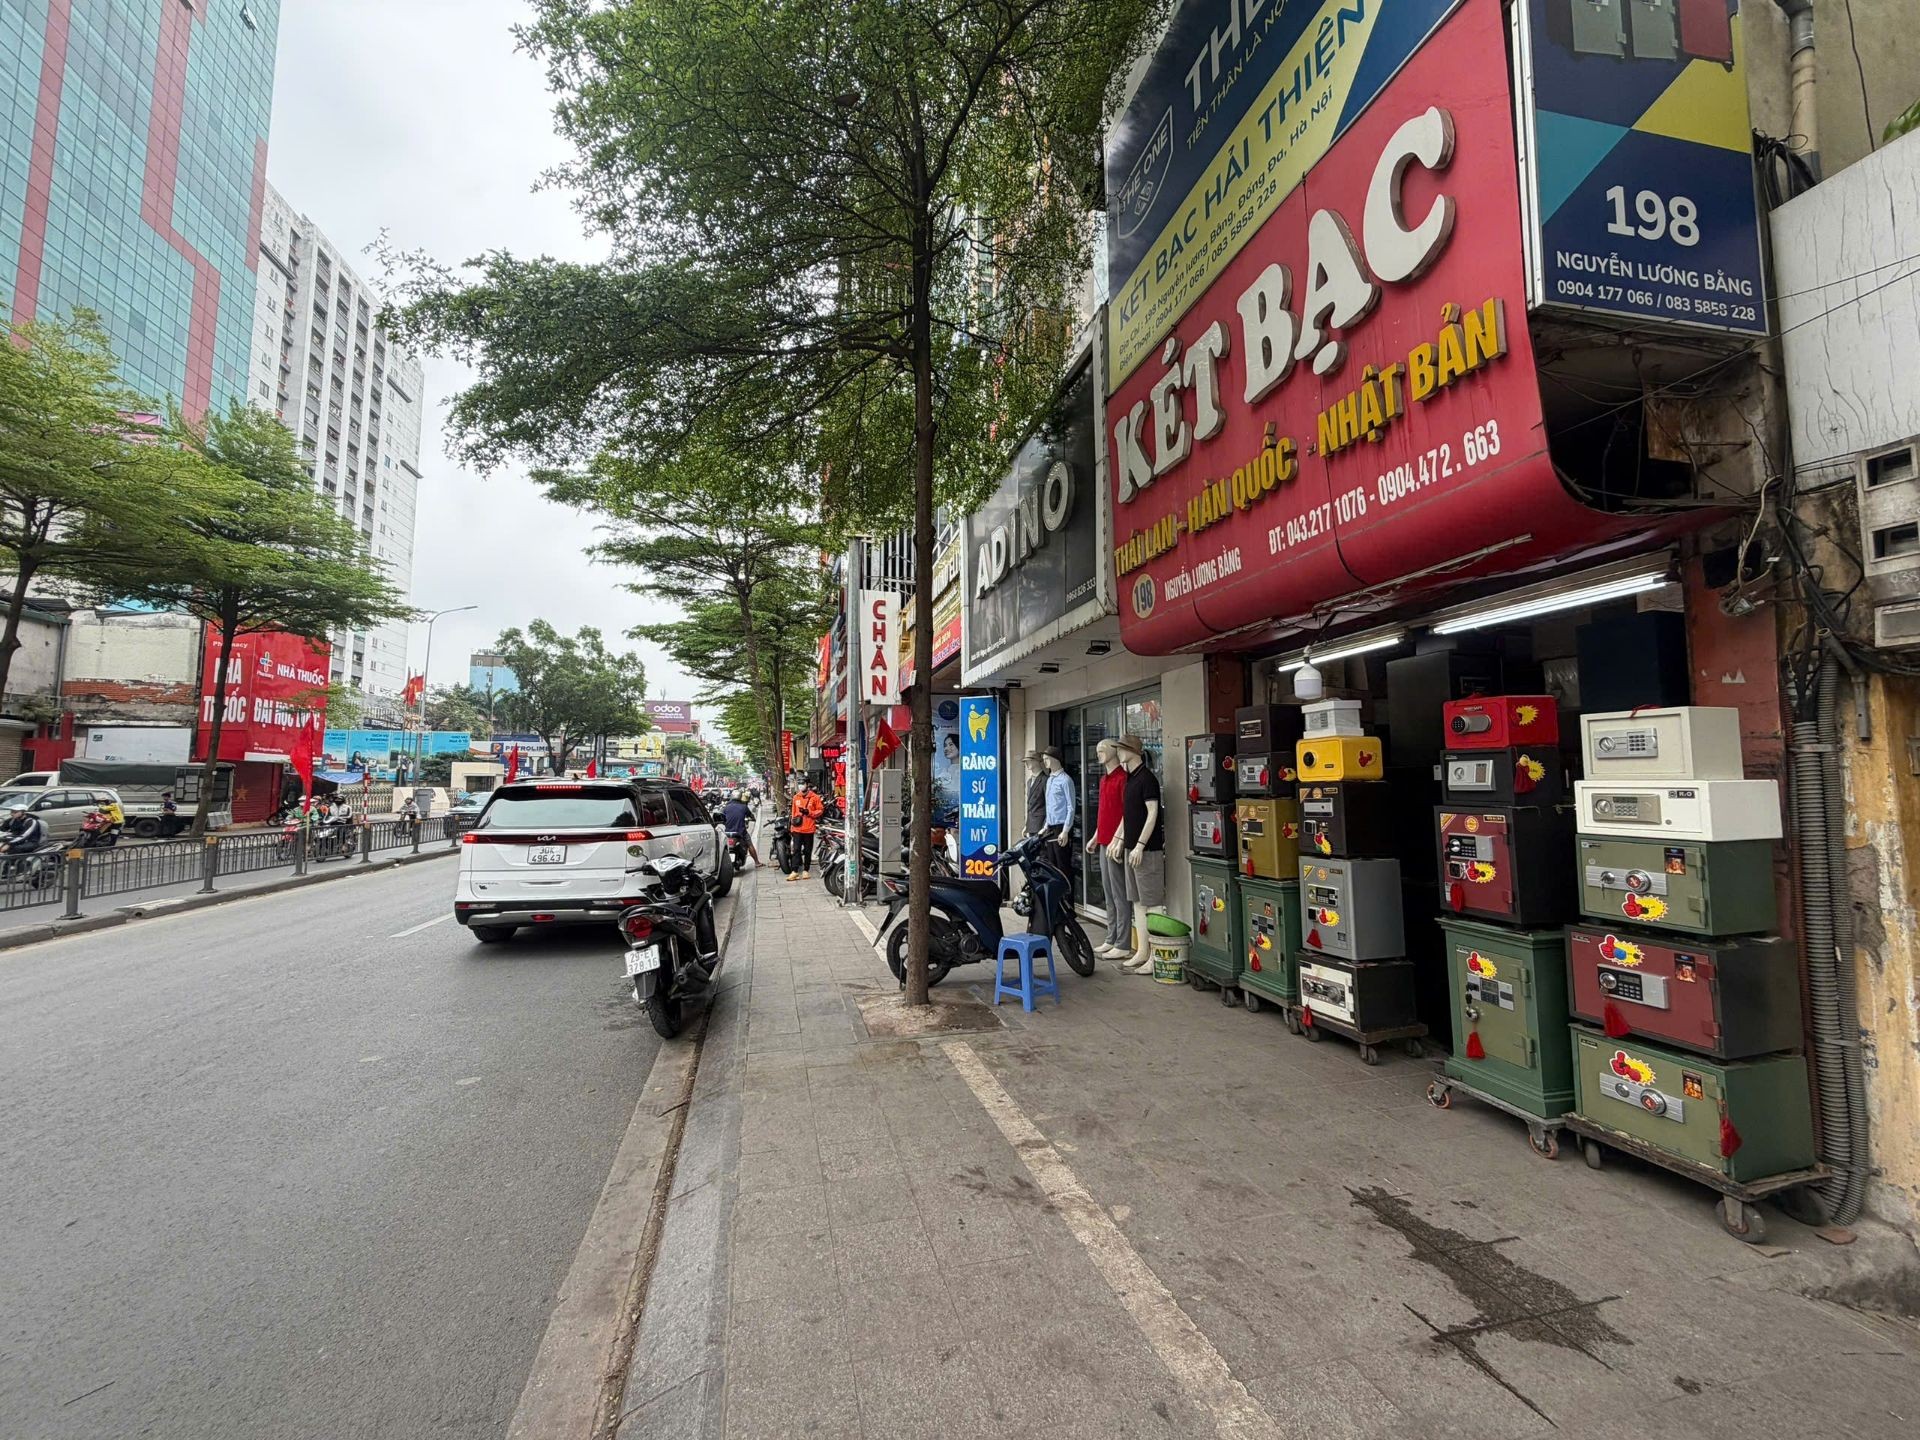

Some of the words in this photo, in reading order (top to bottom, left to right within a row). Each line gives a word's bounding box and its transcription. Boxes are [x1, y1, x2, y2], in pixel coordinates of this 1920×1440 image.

[1210, 58, 1243, 113] THÂN
[1245, 31, 1262, 63] LÀ
[1119, 271, 1150, 331] KÉT
[1155, 207, 1198, 284] BẠC
[1204, 136, 1250, 220] HẢI
[1257, 0, 1365, 144] THIỆN
[1143, 124, 1168, 174] ONE
[1238, 173, 1266, 211] Đống
[1290, 120, 1308, 147] Hà
[1311, 85, 1333, 120] Nội
[1605, 185, 1700, 247] 198
[1155, 306, 1173, 328] 0904
[1174, 284, 1188, 306] 177
[1189, 266, 1205, 288] 066
[1211, 239, 1228, 262] 083
[1230, 210, 1254, 242] 5858
[1257, 179, 1277, 211] 228
[1556, 251, 1633, 279] NGUYỄN
[1637, 261, 1699, 288] LƯƠNG
[1703, 268, 1753, 297] BẰNG
[1114, 320, 1228, 503] KÉT
[1237, 106, 1450, 403] BẠC
[1557, 279, 1594, 298] 0904
[1597, 284, 1623, 302] 177
[1627, 288, 1653, 306] 066
[1664, 294, 1691, 312] 083
[1694, 299, 1727, 317] 5858
[1731, 304, 1756, 322] 228
[1114, 529, 1143, 577] THÁI
[1144, 514, 1177, 560] LAN
[1187, 479, 1231, 534] HÀN
[1231, 422, 1295, 510] QUỐC
[1317, 361, 1403, 458] NHẬT
[1409, 297, 1504, 402] BẢN
[1268, 529, 1286, 555] ĐT:
[1334, 486, 1367, 526] 1076
[1463, 419, 1501, 467] 663
[976, 460, 1074, 600] ADINO
[1086, 576, 1096, 591] 333
[1134, 579, 1153, 613] 198
[1192, 559, 1218, 590] LƯƠNG
[1217, 544, 1242, 578] BẰNG
[870, 599, 887, 696] CHĂN
[277, 663, 295, 680] NHÀ
[297, 668, 325, 686] THUỐC
[253, 697, 273, 728] ĐẠI
[653, 704, 681, 713] odoo
[962, 752, 997, 771] RĂNG
[971, 777, 987, 794] SỨ
[962, 796, 996, 819] THẨM
[539, 847, 555, 855] 30K
[970, 826, 988, 842] MỸ
[1155, 948, 1179, 960] ATM
